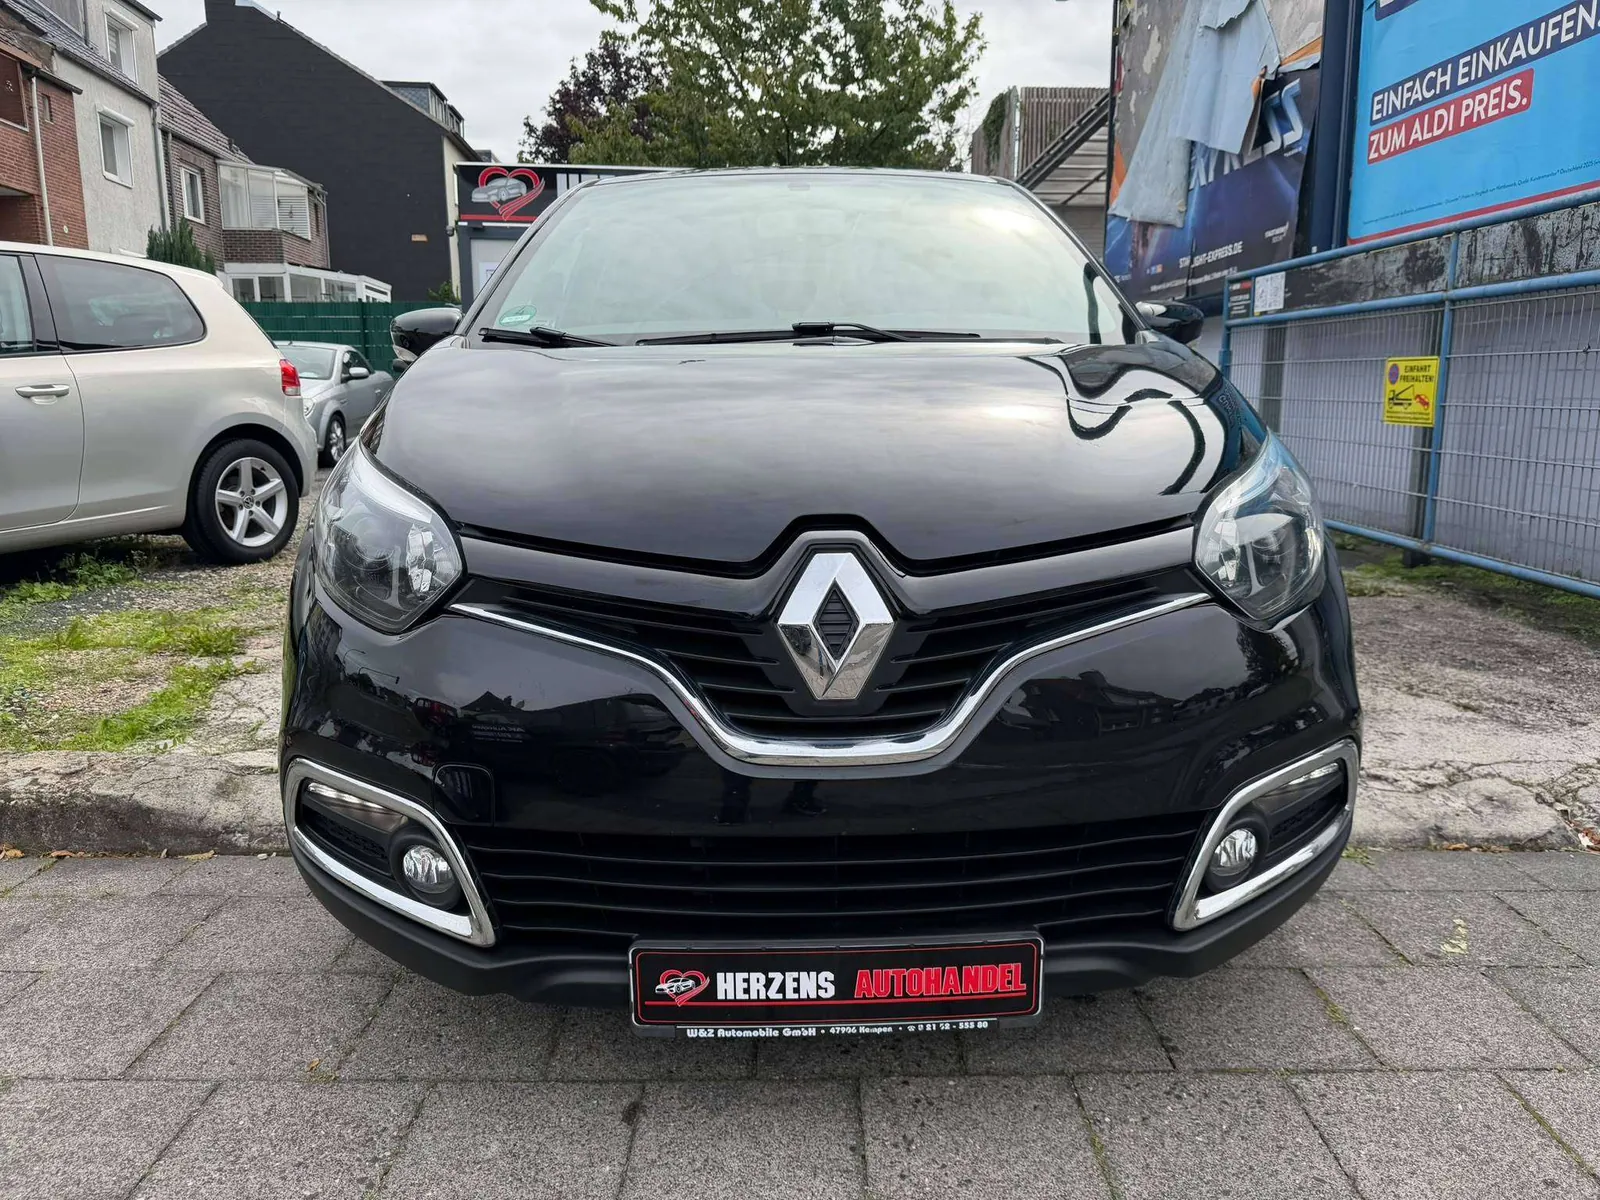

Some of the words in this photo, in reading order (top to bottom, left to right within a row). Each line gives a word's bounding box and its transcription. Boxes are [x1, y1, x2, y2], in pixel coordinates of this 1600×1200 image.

[1372, 64, 1452, 121] EINFACH
[1369, 124, 1405, 160] ZUM
[1408, 104, 1455, 147] ALDI
[1460, 79, 1528, 128] PREIS.
[1404, 365, 1431, 373] EINFAHRT
[716, 971, 835, 1000] HERZENS
[854, 963, 1027, 998] AUTOHANDEL
[687, 1028, 714, 1037] W&Z
[717, 1028, 779, 1037] Automobile
[782, 1028, 816, 1037] GmbH
[859, 1026, 893, 1034] Kempen
[925, 1023, 937, 1031] 21
